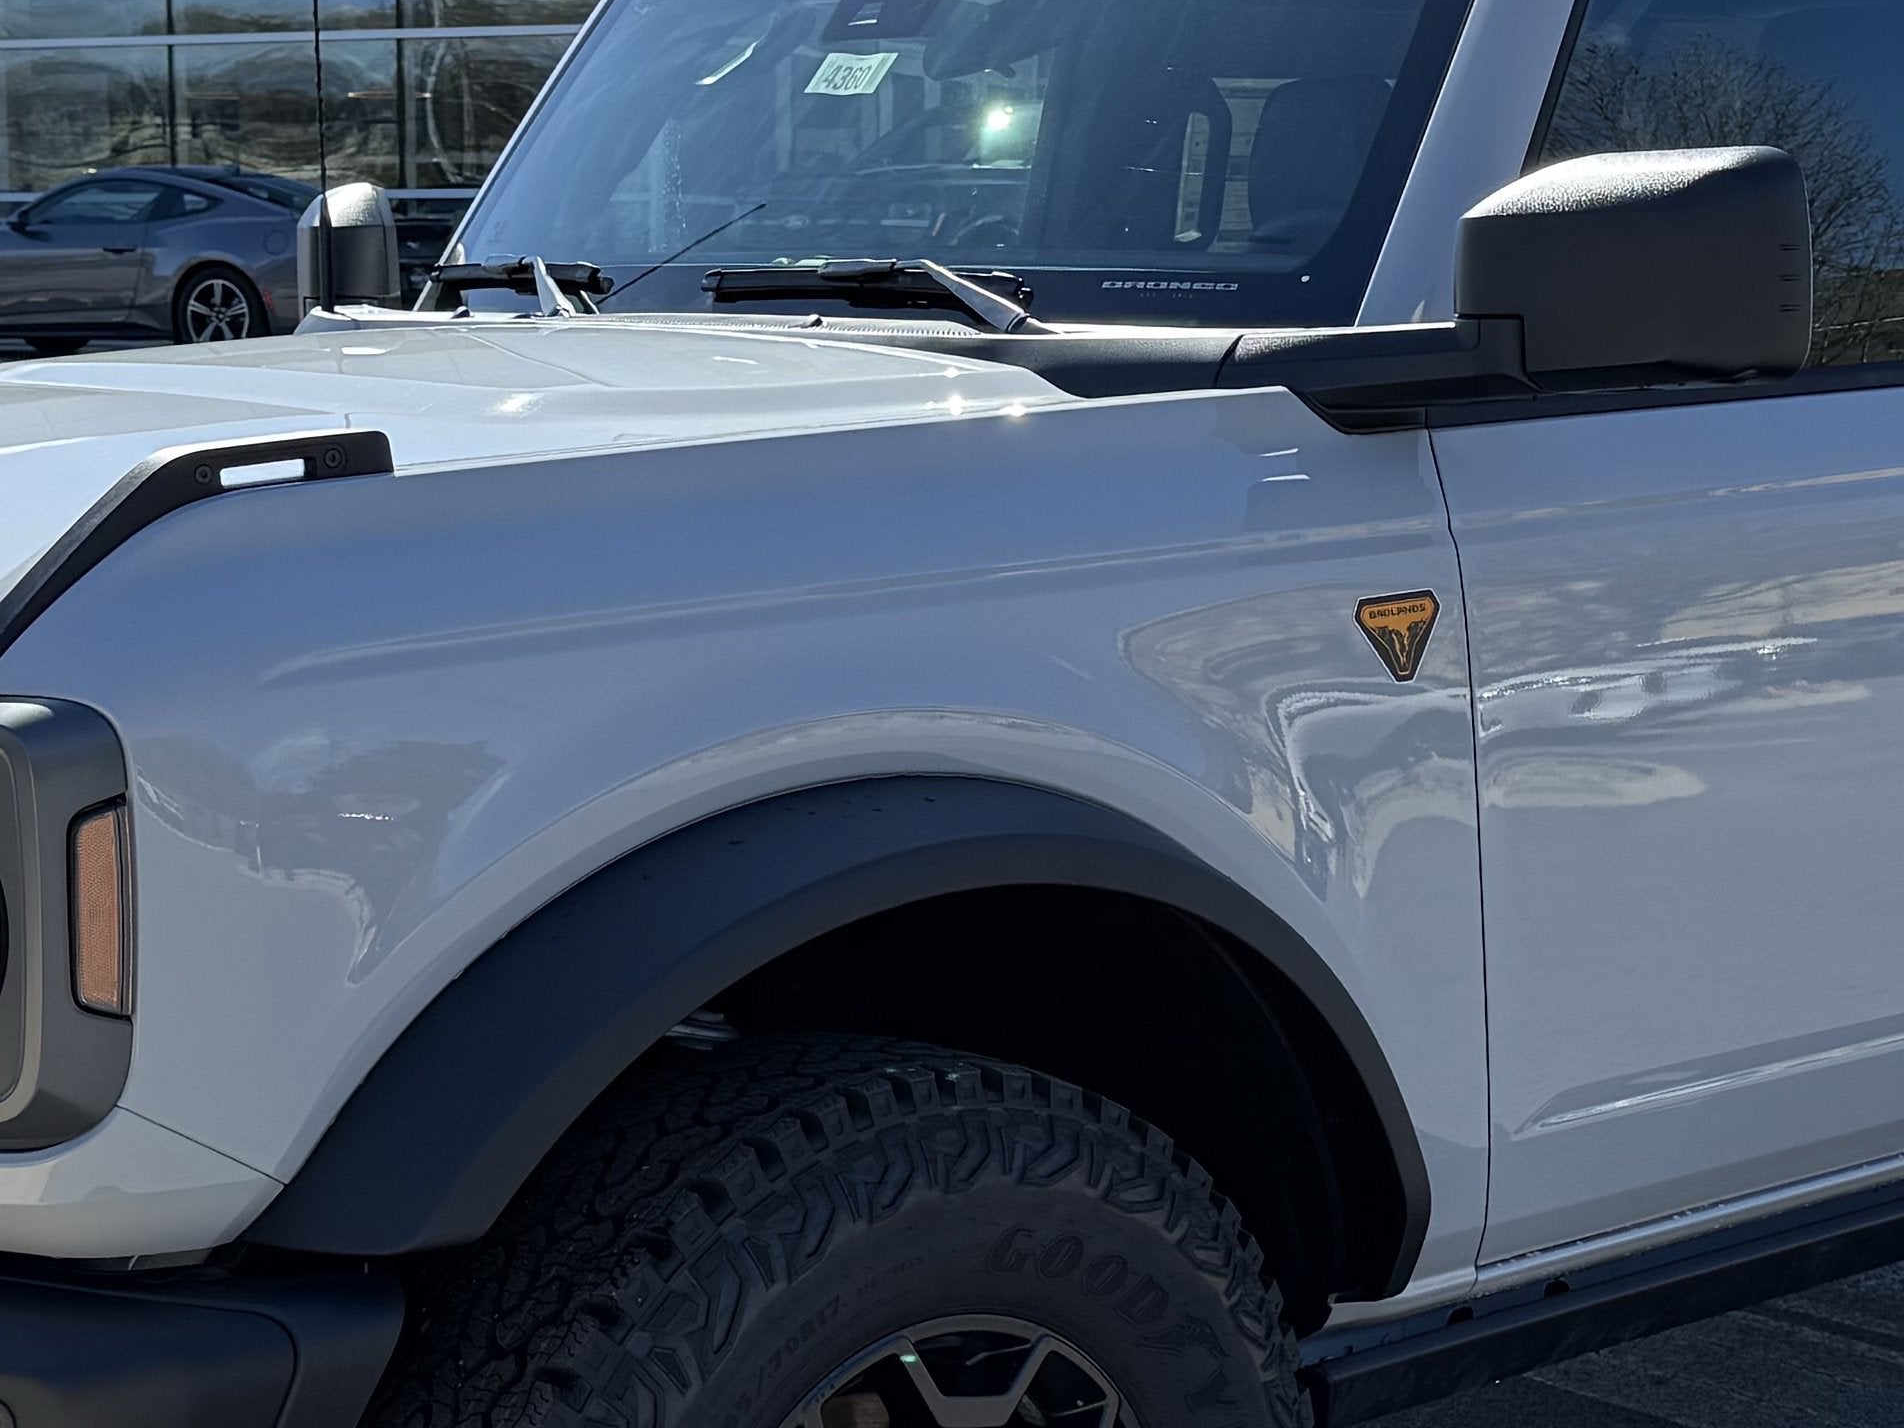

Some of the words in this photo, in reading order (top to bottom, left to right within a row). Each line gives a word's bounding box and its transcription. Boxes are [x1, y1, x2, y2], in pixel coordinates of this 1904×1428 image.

[821, 64, 873, 91] 4360
[1101, 281, 1240, 291] BRONCO
[1369, 603, 1426, 620] BADLANDS
